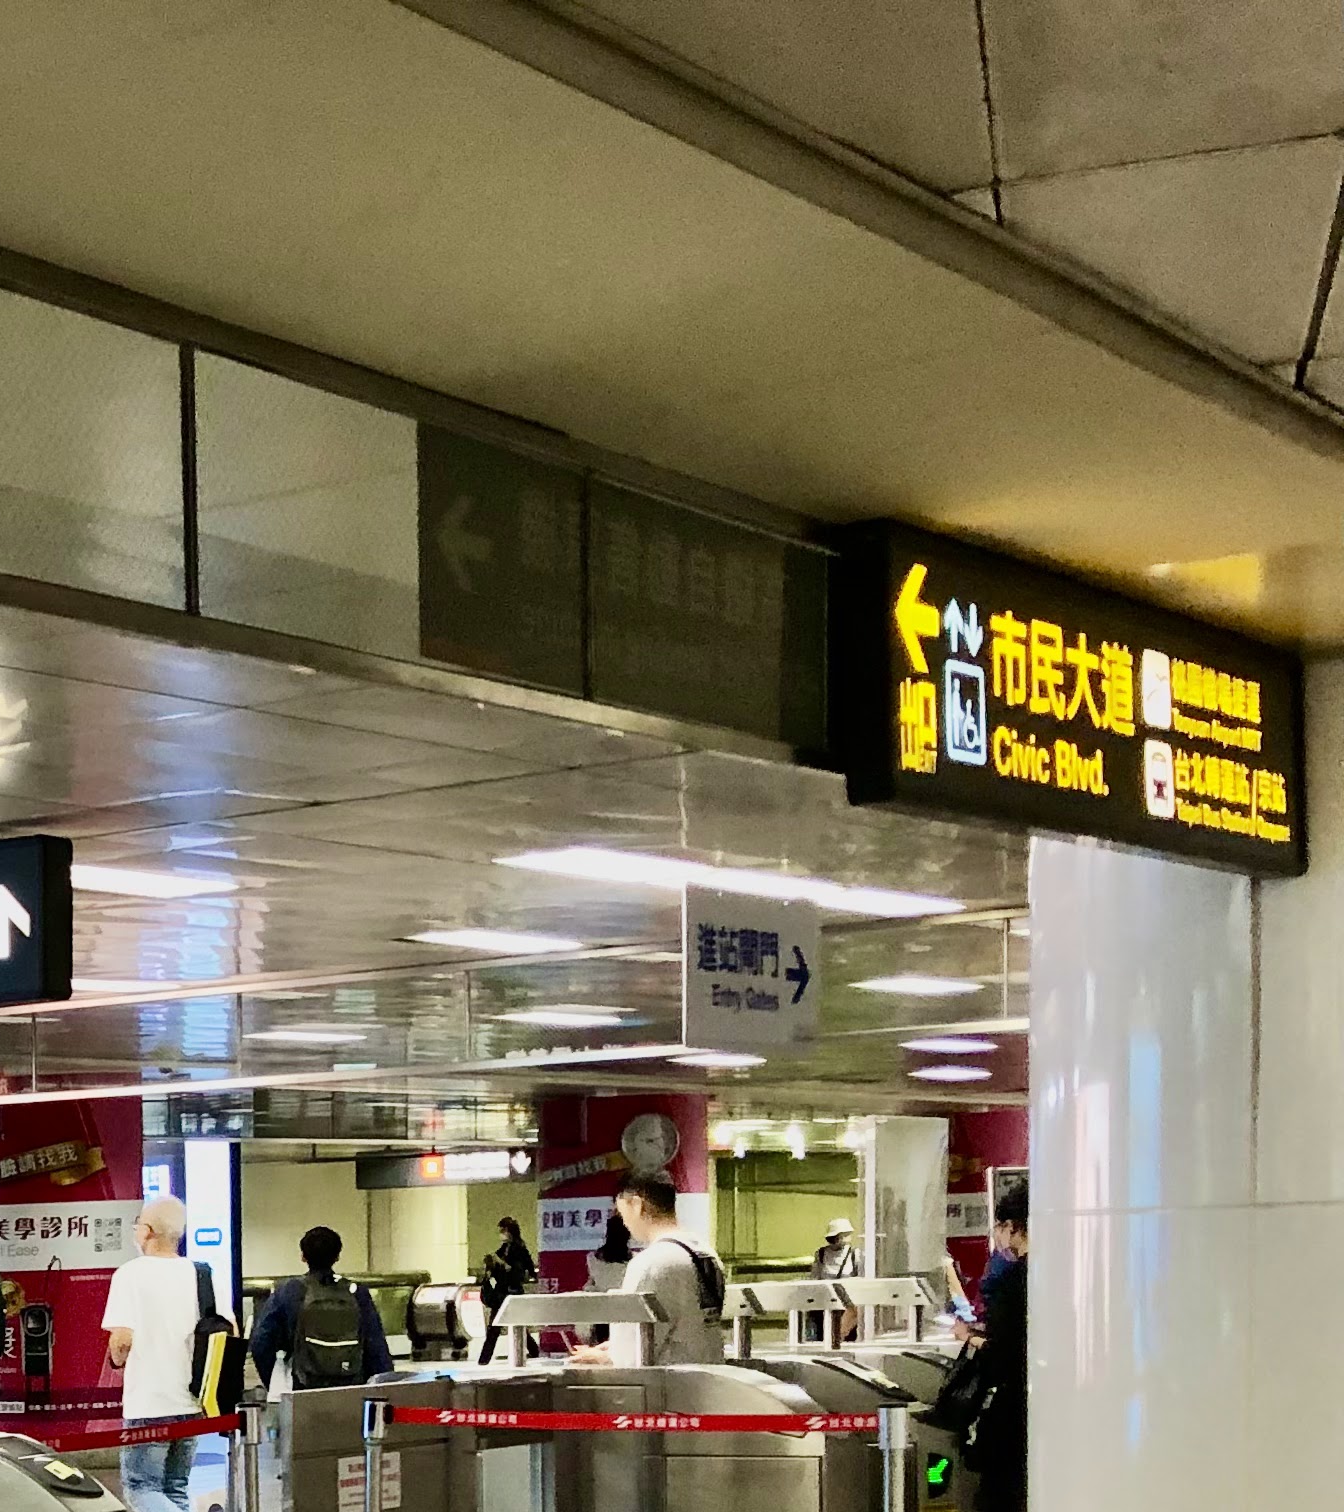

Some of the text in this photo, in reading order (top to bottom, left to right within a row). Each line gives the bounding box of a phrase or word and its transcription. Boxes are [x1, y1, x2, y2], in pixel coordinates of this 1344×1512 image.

[989, 610, 1136, 737] 市民大道
[993, 725, 1110, 796] Civic Blvd.
